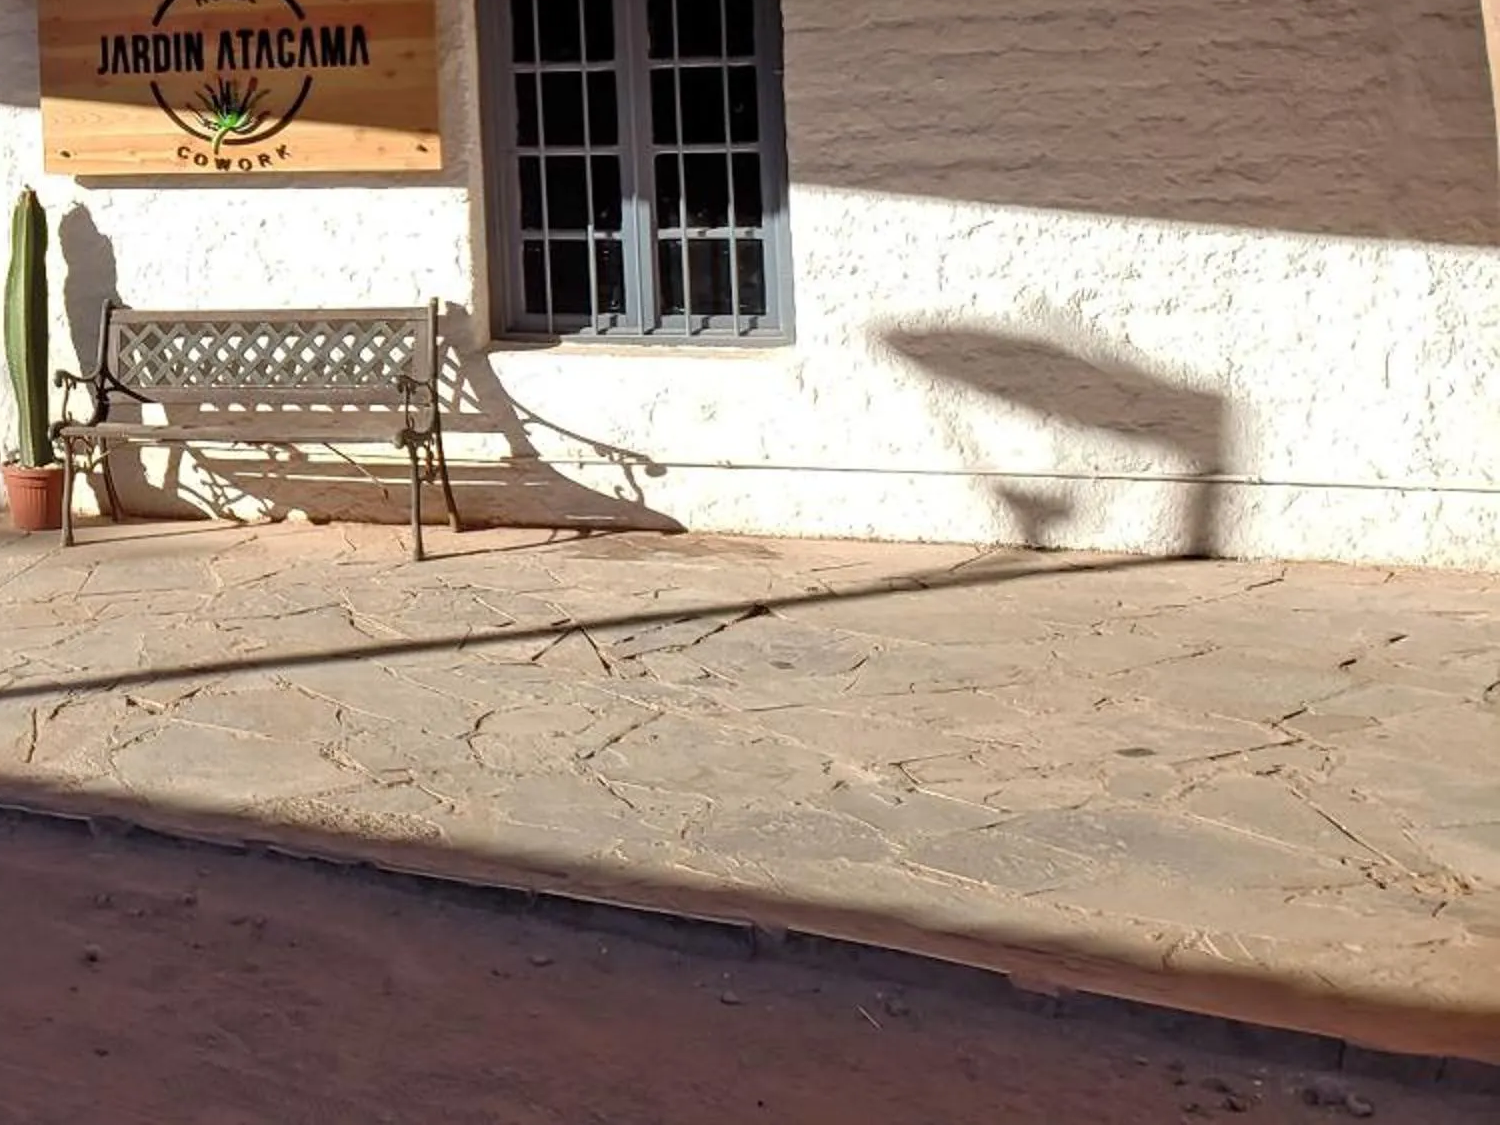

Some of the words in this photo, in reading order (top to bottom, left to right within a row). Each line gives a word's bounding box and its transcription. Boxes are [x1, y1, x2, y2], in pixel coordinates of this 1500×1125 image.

[97, 31, 204, 75] JARDIN
[217, 24, 370, 70] ATACAMA
[176, 144, 291, 172] COWORK
